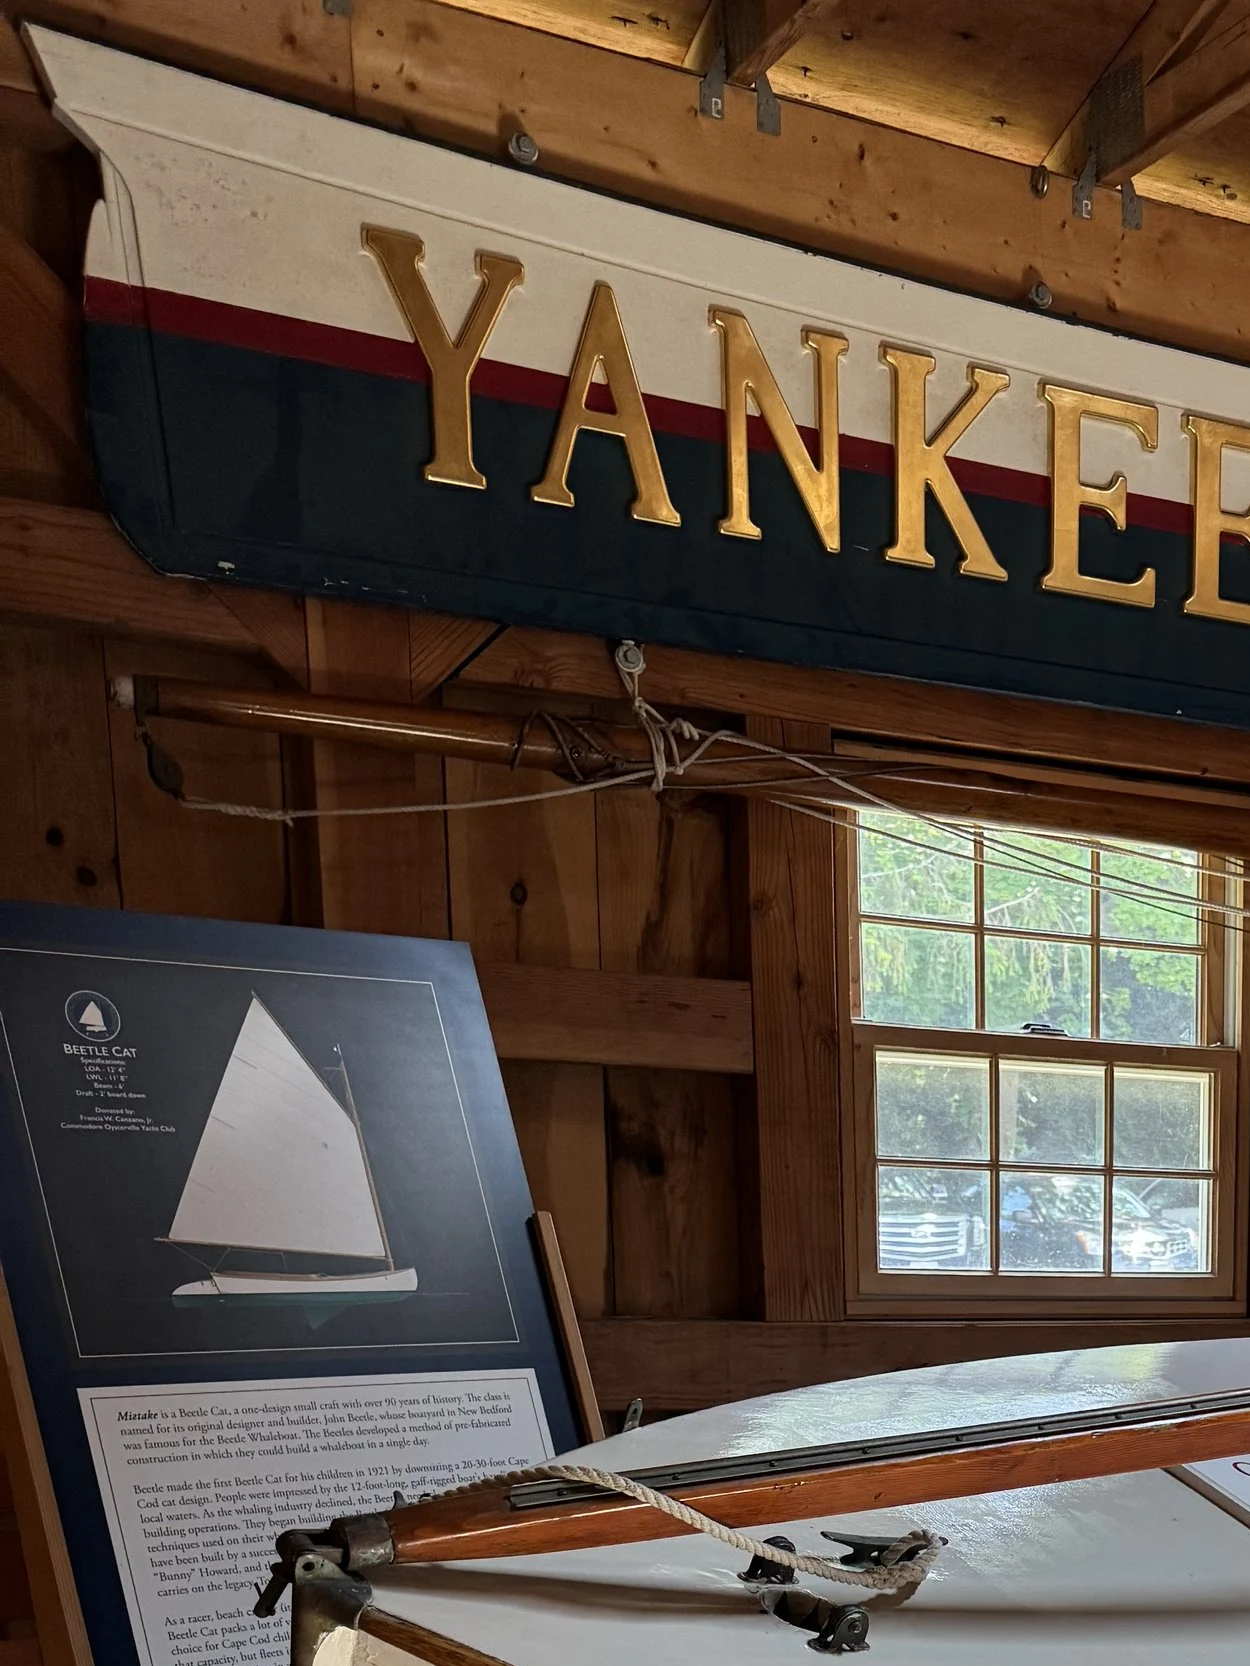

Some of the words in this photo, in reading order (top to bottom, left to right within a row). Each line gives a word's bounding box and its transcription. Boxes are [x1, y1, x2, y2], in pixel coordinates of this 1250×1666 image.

[63, 1043, 109, 1056] BEETLE
[112, 1046, 138, 1058] CAT
[178, 1407, 208, 1418] Beetle
[241, 1403, 291, 1415] one-design
[293, 1400, 317, 1412] small
[319, 1399, 340, 1410] craft
[341, 1398, 362, 1408] with
[384, 1397, 397, 1407] 90
[398, 1398, 420, 1408] years
[421, 1394, 431, 1404] of
[464, 1392, 481, 1402] The
[483, 1391, 502, 1401] class
[120, 1423, 154, 1436] named
[156, 1423, 171, 1434] for
[172, 1423, 185, 1433] its
[187, 1419, 224, 1434] original
[226, 1419, 264, 1431] designer
[267, 1416, 285, 1427] and
[323, 1413, 345, 1426] John
[378, 1410, 406, 1420] whose
[407, 1407, 445, 1421] boatyard
[446, 1408, 456, 1417] in
[457, 1406, 477, 1416] New
[479, 1404, 512, 1414] Bedford
[144, 1438, 180, 1449] famous
[182, 1436, 196, 1447] for
[199, 1435, 214, 1446] the
[216, 1433, 246, 1445] Beetle
[302, 1428, 321, 1439] The
[322, 1426, 354, 1438] Beetles
[355, 1423, 400, 1437] developed
[408, 1421, 442, 1432] method
[443, 1420, 453, 1430] of
[454, 1417, 511, 1432] pre-fabricated
[126, 1452, 189, 1465] construction
[190, 1451, 201, 1461] in
[203, 1448, 233, 1459] which
[234, 1447, 255, 1460] they
[257, 1444, 284, 1456] could
[285, 1442, 311, 1454] build
[319, 1440, 365, 1451] whaleboat
[366, 1439, 377, 1448] in
[386, 1436, 411, 1449] single
[133, 1482, 164, 1495] Beetle
[166, 1480, 193, 1492] made
[195, 1479, 211, 1490] the
[213, 1477, 232, 1488] first
[234, 1475, 263, 1487] Beetle
[265, 1474, 283, 1484] Cat
[284, 1472, 298, 1483] for
[299, 1471, 315, 1482] his
[316, 1468, 354, 1480] children
[355, 1468, 365, 1477] in
[367, 1466, 389, 1476] 1921
[391, 1465, 402, 1477] by
[461, 1457, 507, 1469] 20-30-foot
[507, 1456, 529, 1468] Cape
[136, 1497, 159, 1509] Cod
[161, 1499, 176, 1507] cat
[214, 1490, 246, 1504] People
[248, 1492, 271, 1500] were
[272, 1484, 318, 1500] impressed
[318, 1484, 331, 1496] by
[333, 1482, 348, 1493] the
[410, 1473, 456, 1489] gaff-rigged
[139, 1512, 164, 1524] local
[202, 1508, 215, 1519] As
[217, 1506, 232, 1517] the
[234, 1503, 273, 1516] whaling
[274, 1501, 313, 1512] industry
[357, 1494, 372, 1505] the
[142, 1526, 187, 1538] building
[241, 1518, 266, 1531] They
[267, 1517, 296, 1529] began
[147, 1541, 200, 1553] techniques
[201, 1535, 224, 1547] used
[241, 1533, 264, 1544] their
[149, 1557, 174, 1568] have
[174, 1555, 199, 1565] been
[200, 1550, 225, 1563] built
[225, 1549, 239, 1562] by
[243, 1560, 262, 1573] and
[157, 1585, 189, 1597] carries
[191, 1585, 204, 1593] on
[206, 1580, 223, 1592] the
[164, 1616, 177, 1627] As
[215, 1607, 244, 1620] beach
[167, 1627, 198, 1641] Beetle
[199, 1626, 218, 1637] Cat
[220, 1622, 248, 1638] packs
[256, 1619, 271, 1630] lot
[272, 1616, 283, 1628] of
[170, 1643, 203, 1656] choice
[204, 1640, 219, 1651] for
[221, 1638, 247, 1651] Cape
[249, 1633, 271, 1645] Cod
[239, 1651, 257, 1661] but
[259, 1648, 284, 1659] fleets
